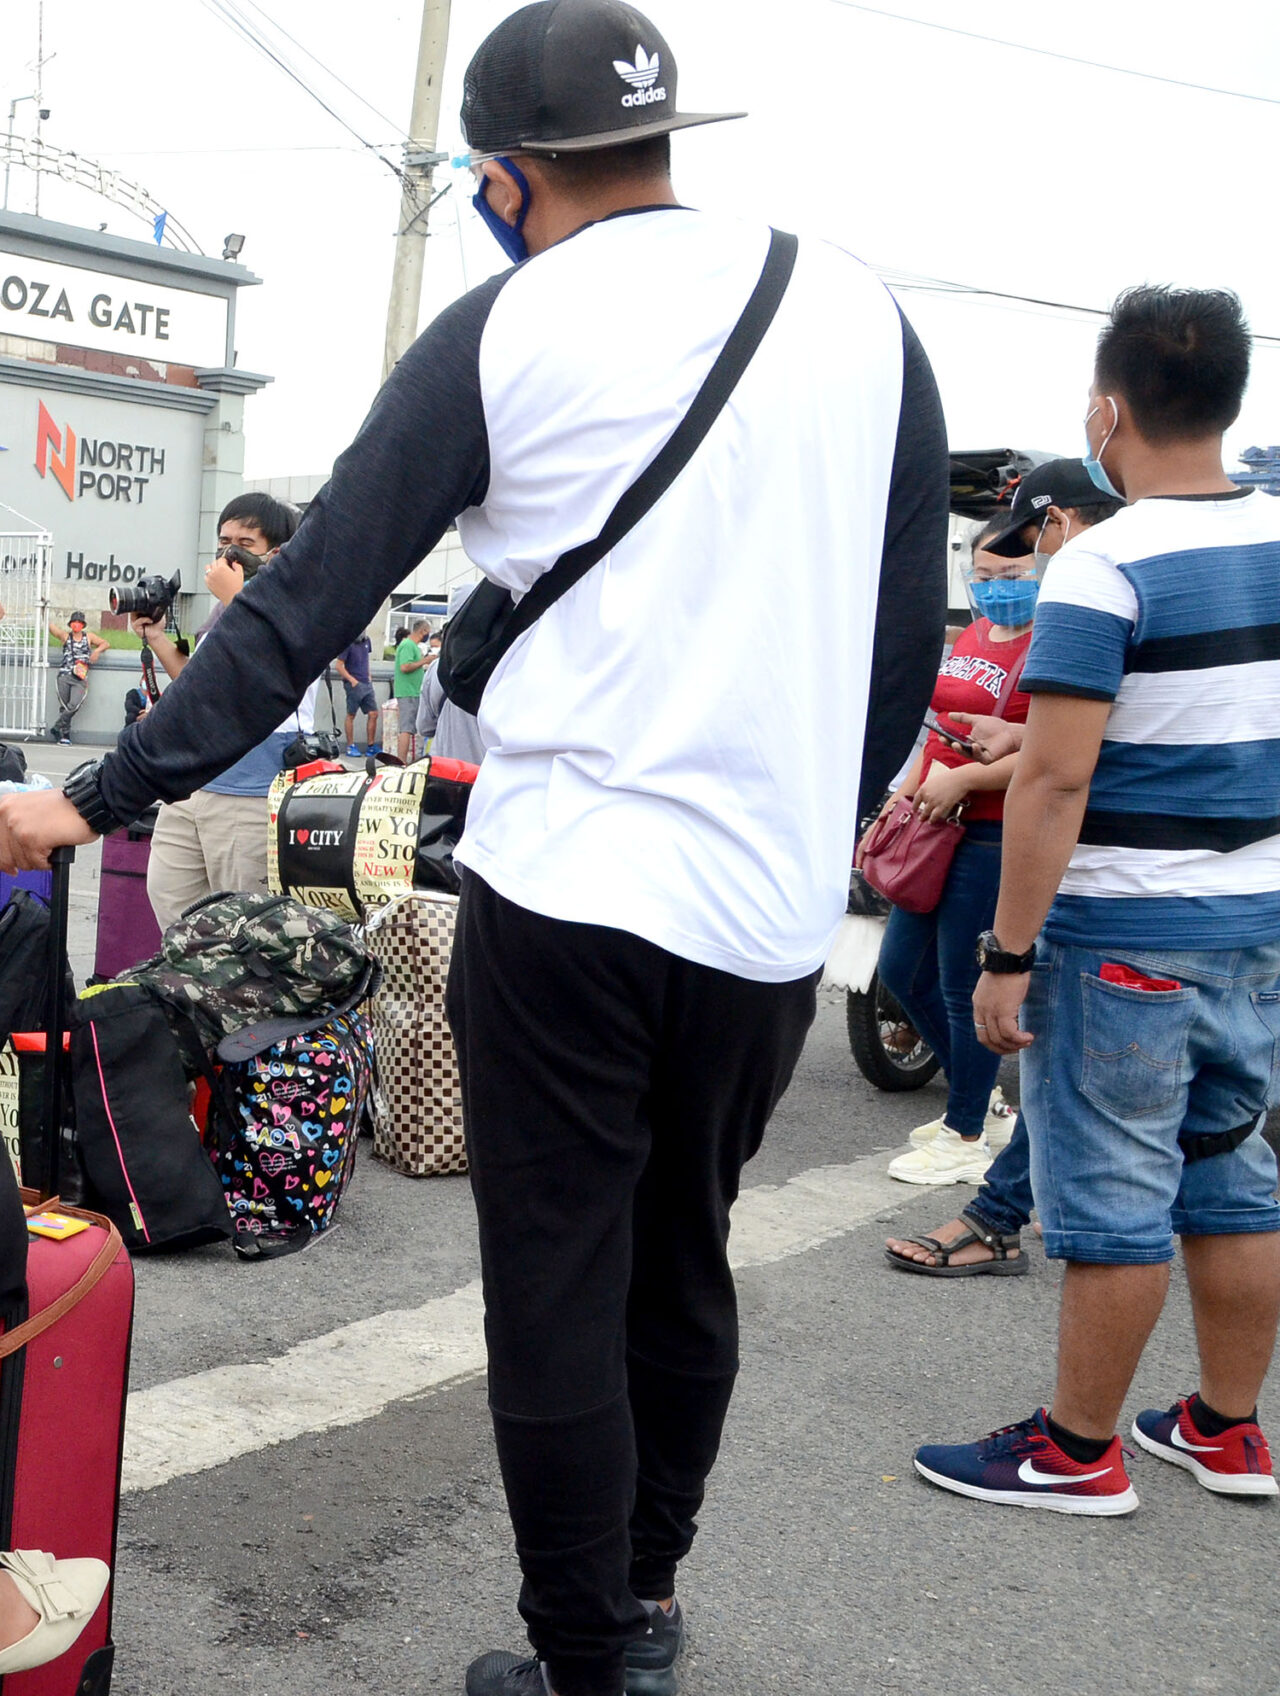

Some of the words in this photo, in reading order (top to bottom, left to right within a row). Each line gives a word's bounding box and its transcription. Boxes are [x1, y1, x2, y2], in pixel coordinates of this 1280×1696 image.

[621, 87, 667, 107] adidas
[88, 294, 170, 340] GATE
[79, 437, 165, 475] NORTH
[78, 470, 149, 504] PORT
[66, 551, 146, 583] Harbor
[309, 829, 344, 846] CITY
[363, 862, 398, 877] NEW
